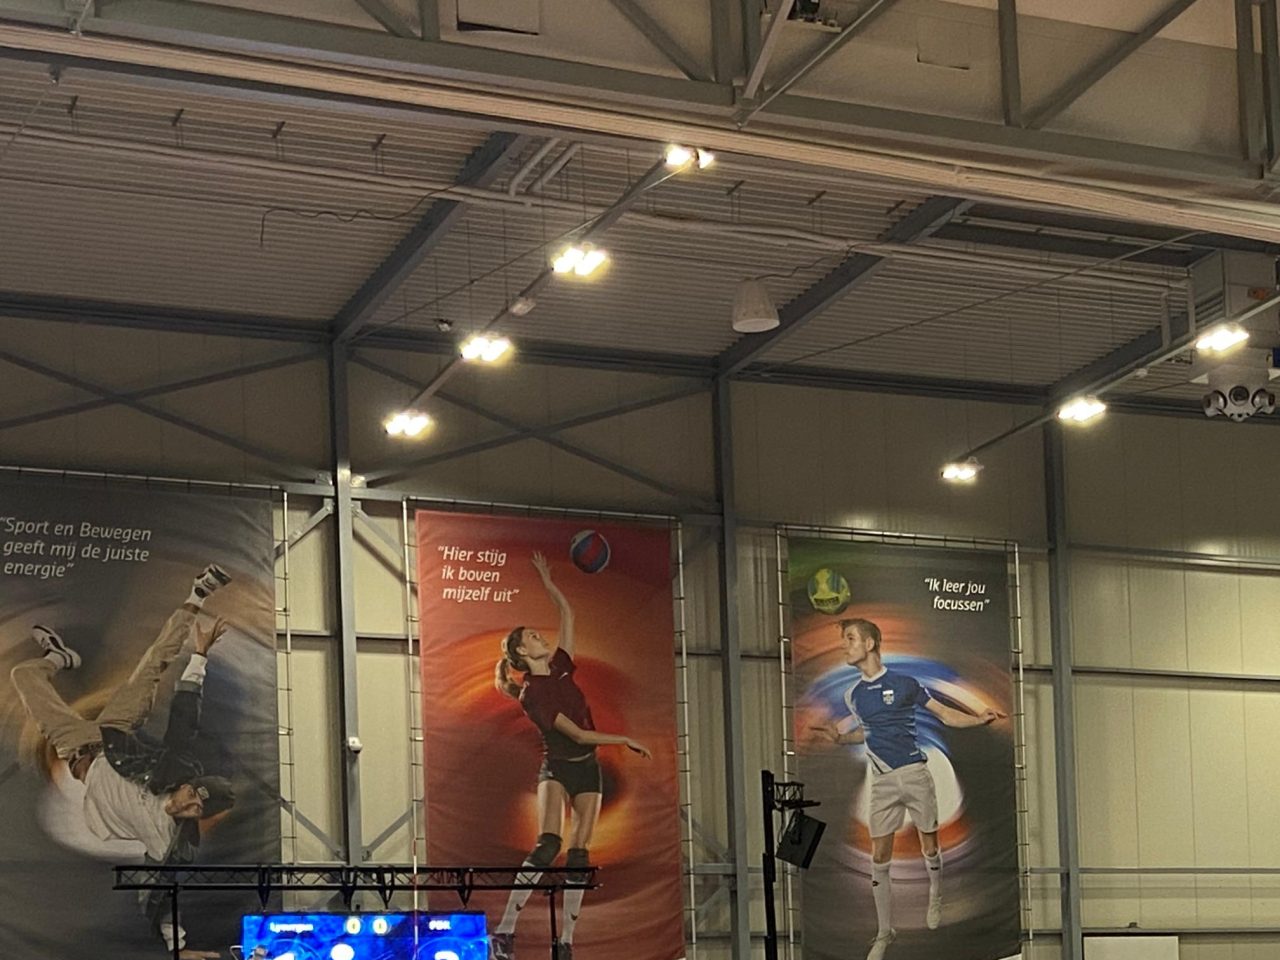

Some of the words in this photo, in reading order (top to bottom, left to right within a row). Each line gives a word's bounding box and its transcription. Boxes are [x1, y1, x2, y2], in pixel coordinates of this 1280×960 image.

[54, 524, 73, 536] en
[80, 522, 151, 542] Bewegen
[4, 539, 44, 556] geeft
[50, 543, 76, 560] mij
[81, 543, 100, 558] de
[102, 544, 149, 562] juiste
[477, 549, 507, 566] stijg
[441, 565, 454, 579] ik
[458, 566, 500, 582] boven
[442, 586, 490, 603] mijzelf
[942, 580, 965, 593] leer
[966, 582, 985, 596] jou
